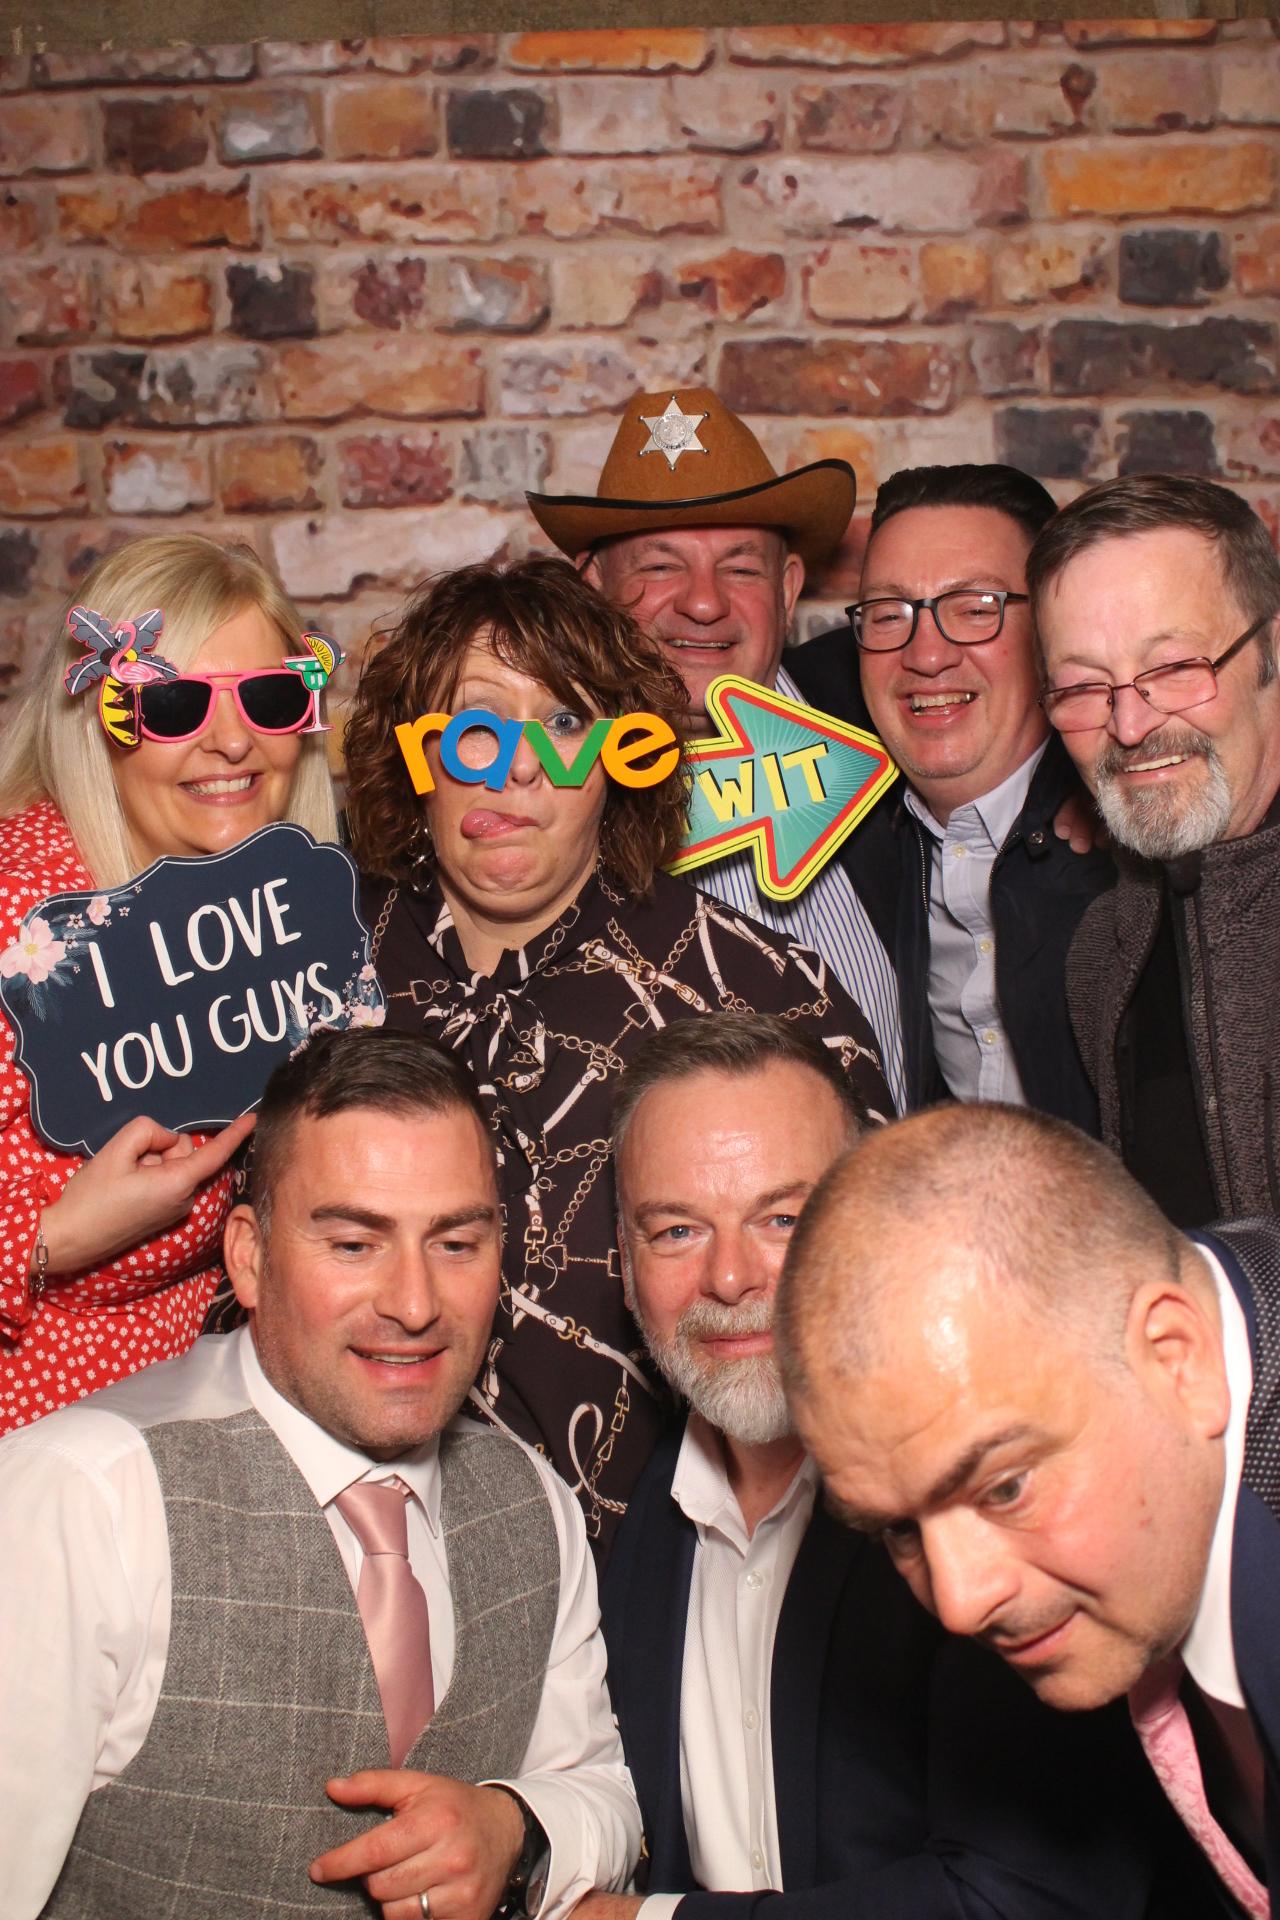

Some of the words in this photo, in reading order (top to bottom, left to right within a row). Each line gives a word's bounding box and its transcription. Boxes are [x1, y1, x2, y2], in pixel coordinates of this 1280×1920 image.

[394, 709, 680, 795] rave
[682, 741, 829, 835] WIT
[88, 942, 115, 1008] I
[149, 878, 301, 986] LOVE
[81, 1014, 193, 1101] YOU
[208, 962, 342, 1053] GUYS
